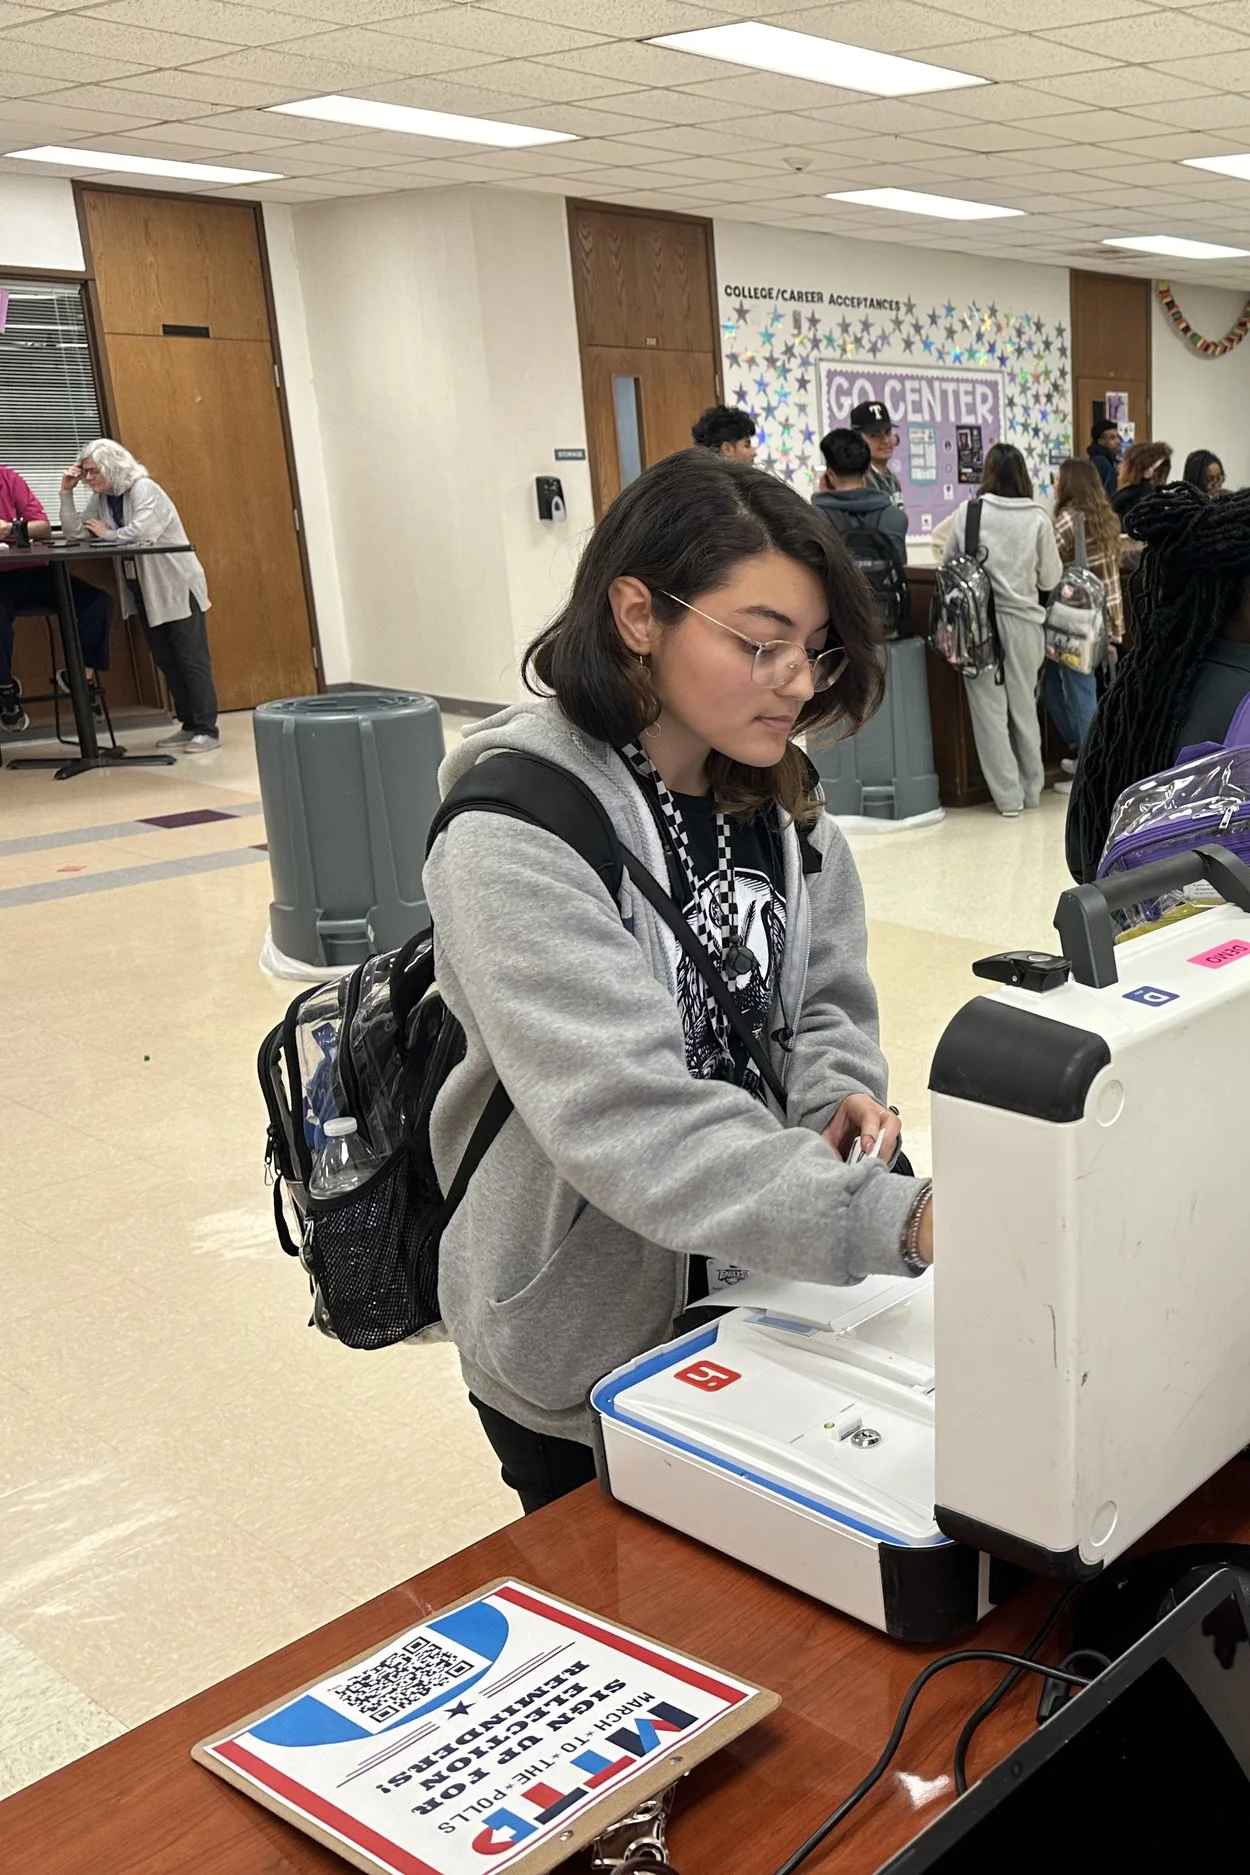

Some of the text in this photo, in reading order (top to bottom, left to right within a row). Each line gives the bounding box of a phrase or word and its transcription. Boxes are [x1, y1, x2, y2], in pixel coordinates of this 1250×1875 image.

[724, 285, 901, 311] COLLEGE/CAREER ACCEPTANCES
[869, 404, 882, 420] T
[883, 378, 993, 424] CENTER
[1205, 944, 1249, 964] DEMO
[375, 1660, 591, 1795] REMINDERS!
[411, 1678, 627, 1816] SIGN UP FOR
[418, 1682, 589, 1792] ELECTION
[437, 1691, 656, 1834] MARCH TO THE POLLS
